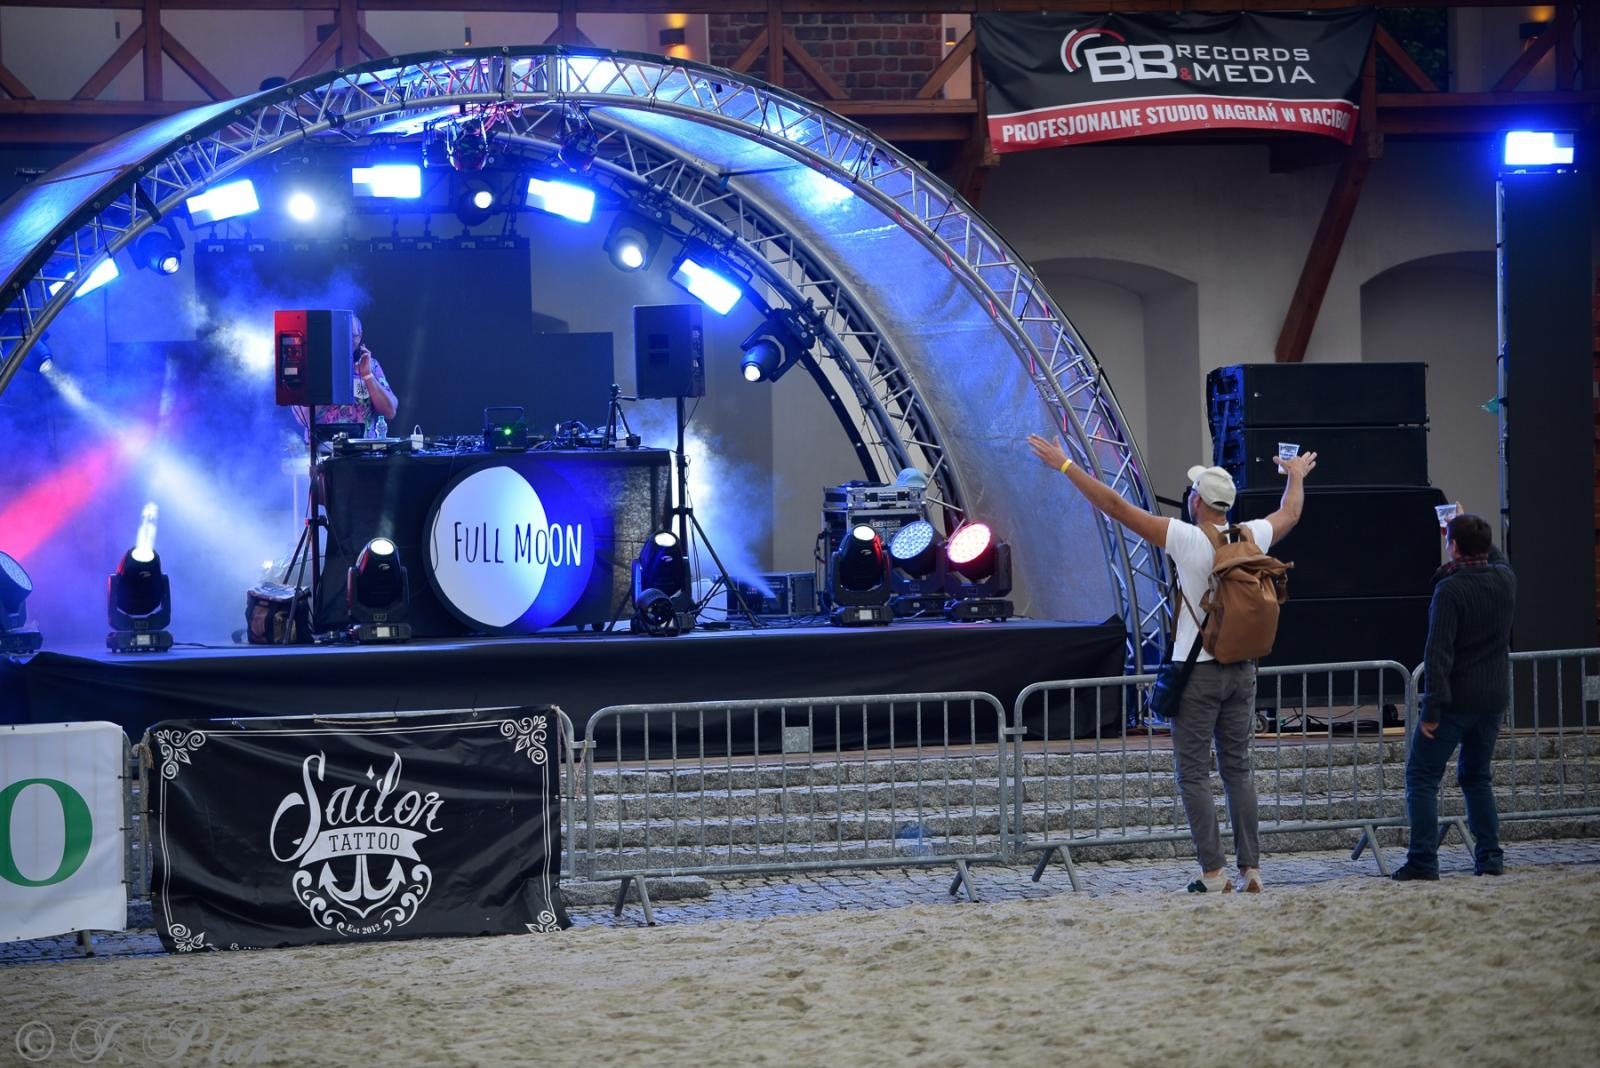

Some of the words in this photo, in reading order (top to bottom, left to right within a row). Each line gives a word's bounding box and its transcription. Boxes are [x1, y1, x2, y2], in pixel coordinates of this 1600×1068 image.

[1084, 44, 1178, 83] BB
[1176, 44, 1310, 61] RECORDS
[1002, 108, 1143, 143] PROFESJONALNE
[1145, 104, 1209, 125] STUDIO
[1211, 102, 1279, 122] NAGRAŃ
[1280, 107, 1297, 122] W
[269, 750, 445, 863] Sailor
[328, 831, 401, 853] TATTOO
[346, 923, 360, 934] Est
